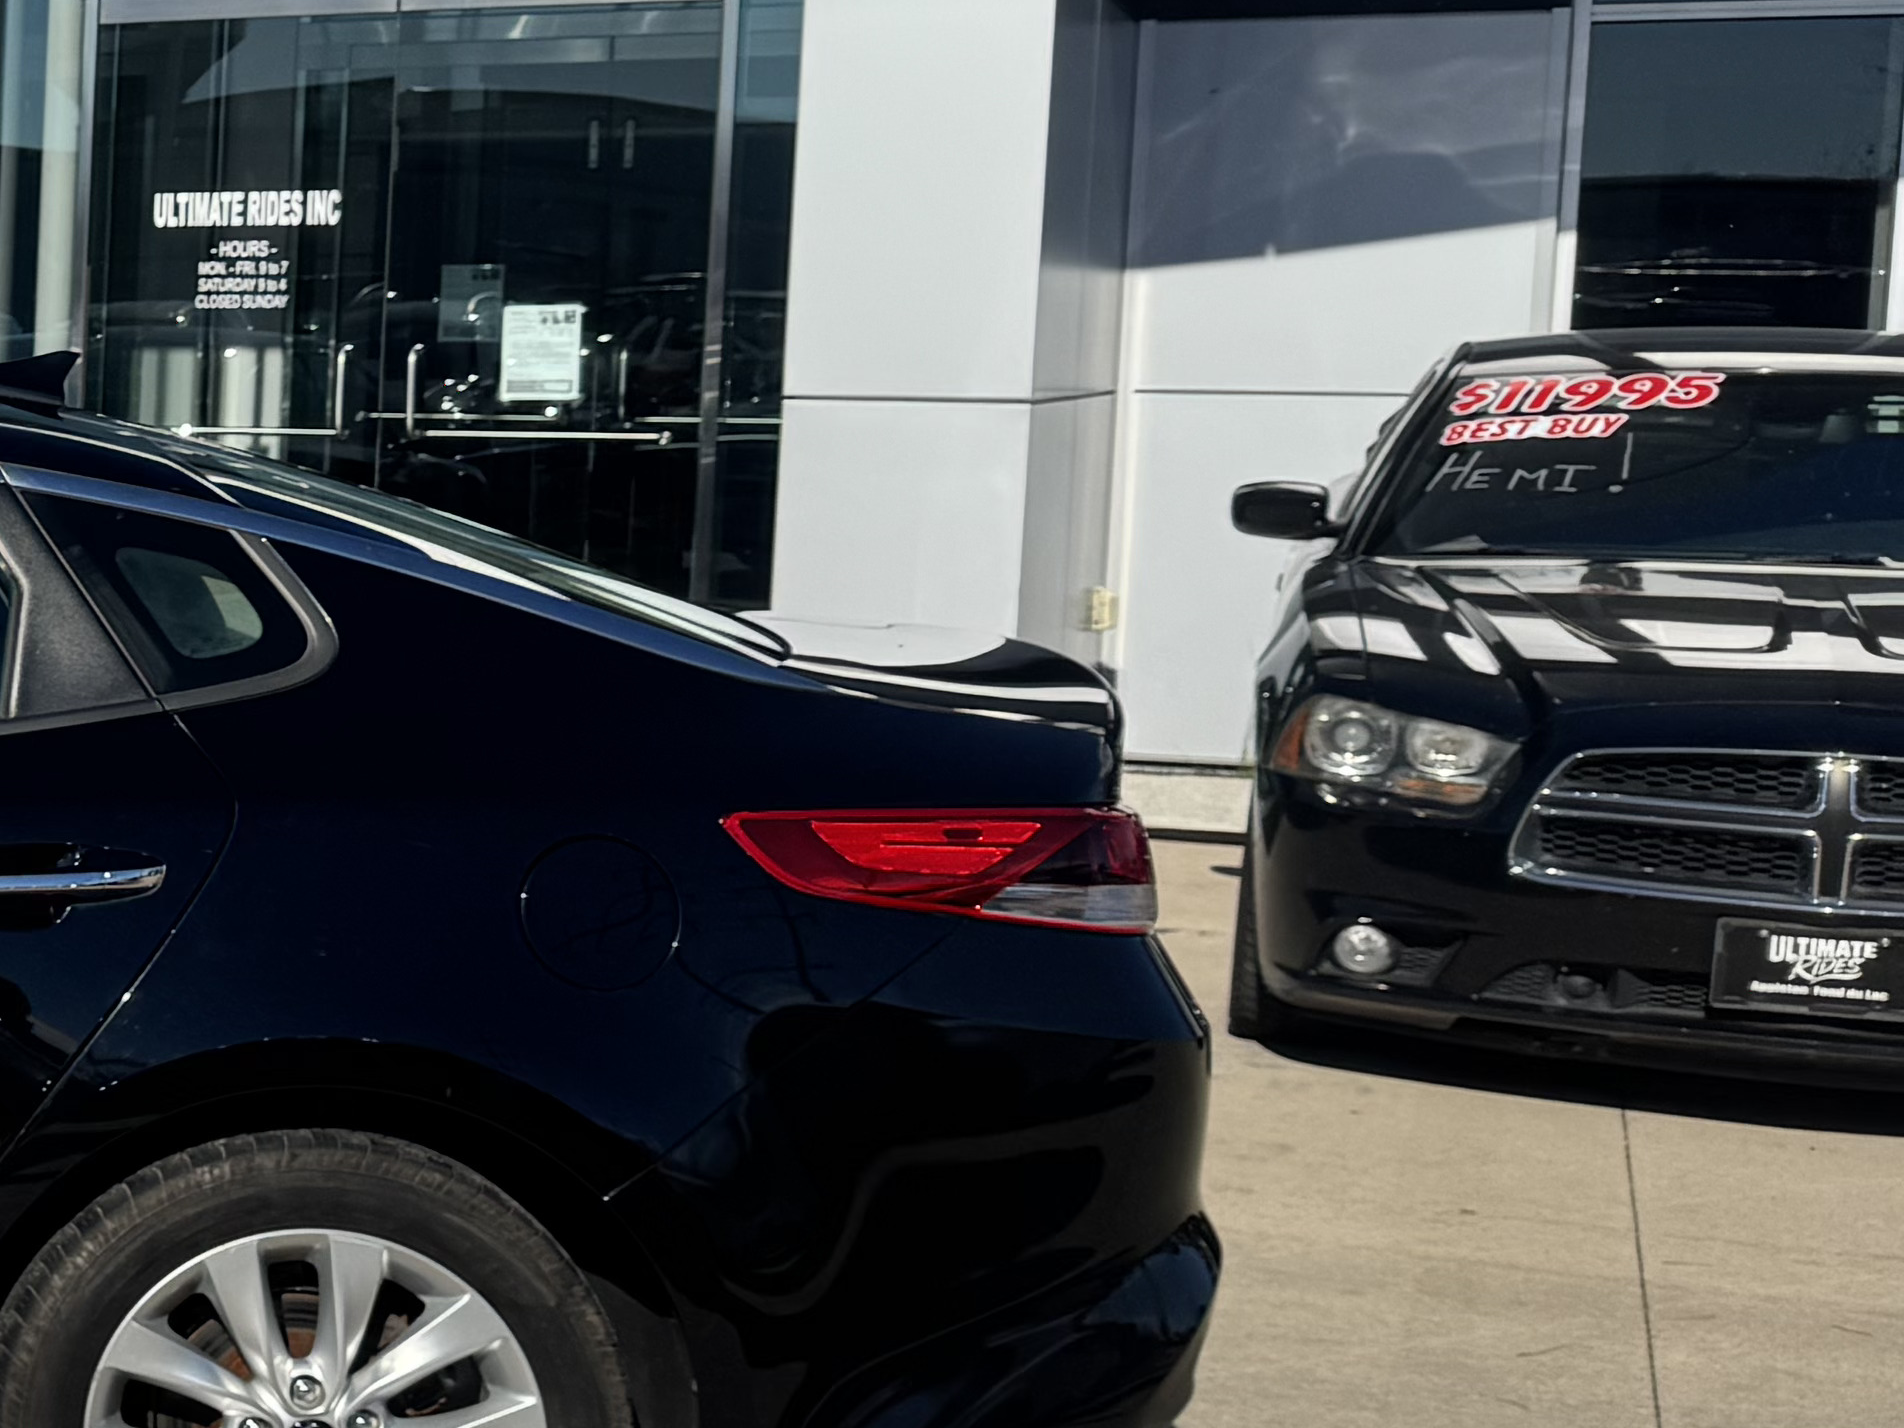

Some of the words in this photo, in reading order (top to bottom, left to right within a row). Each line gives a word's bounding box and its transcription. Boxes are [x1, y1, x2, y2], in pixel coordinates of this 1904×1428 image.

[153, 191, 245, 228] ULTIMATE
[246, 190, 304, 227] RIDES
[305, 189, 342, 226] INC
[218, 240, 270, 258] HOURS
[197, 277, 256, 292] SATURDAY
[194, 294, 241, 309] CLOSED
[241, 294, 290, 309] SUNDAY
[1449, 373, 1726, 415] $11995
[1440, 416, 1538, 445] BEST
[1544, 414, 1630, 440] BUY
[1769, 935, 1880, 963] ULTIMATE
[1788, 955, 1866, 984] RIDES
